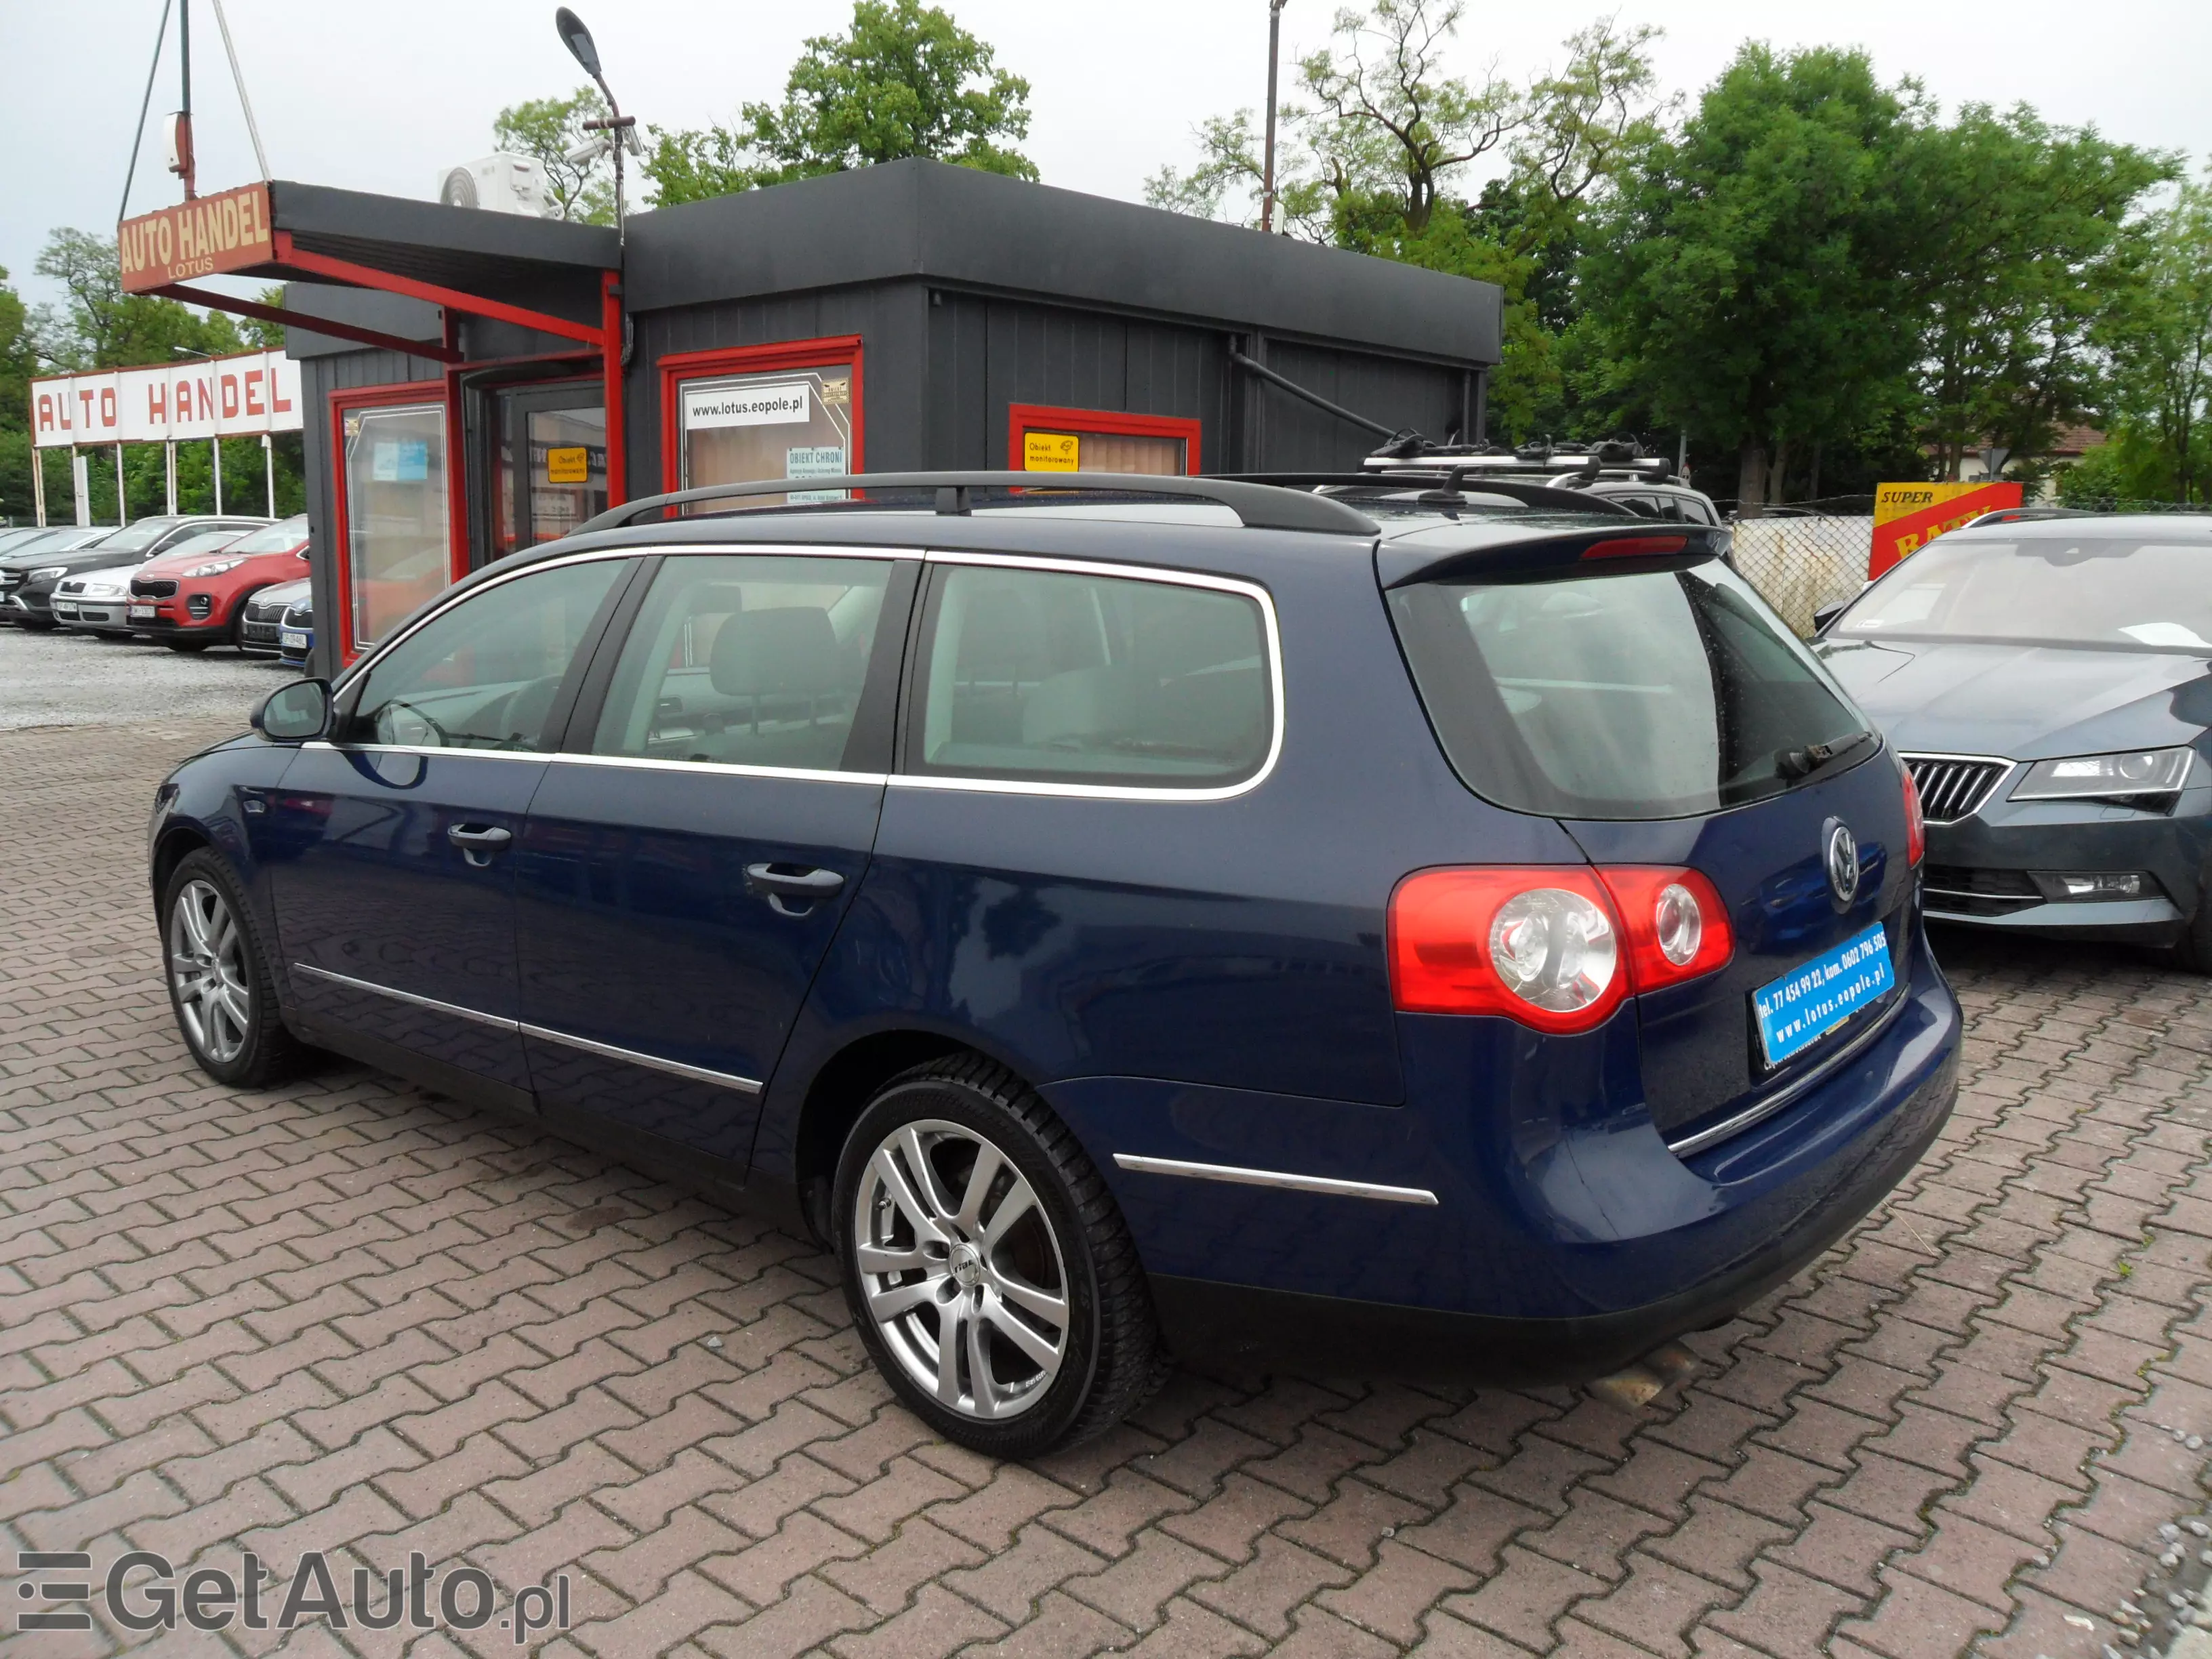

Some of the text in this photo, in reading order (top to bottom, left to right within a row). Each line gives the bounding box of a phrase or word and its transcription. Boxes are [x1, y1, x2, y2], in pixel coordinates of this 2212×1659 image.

[122, 191, 268, 274] AUTO HANDEL
[167, 257, 213, 279] LOTUS
[38, 368, 291, 432] AUTO HANDEL
[693, 396, 802, 417] www.lotus.eopole.pl
[790, 451, 842, 464] OBIEKT CHRONI
[1029, 443, 1051, 451] Obiekt
[1030, 456, 1074, 466] monitorowany
[1881, 491, 1933, 503] SUPER
[1759, 930, 1887, 1019] tel. 77 454 99 22, kom. 0602 796 505
[1776, 962, 1885, 1044] www.lotus.eopole.pl
